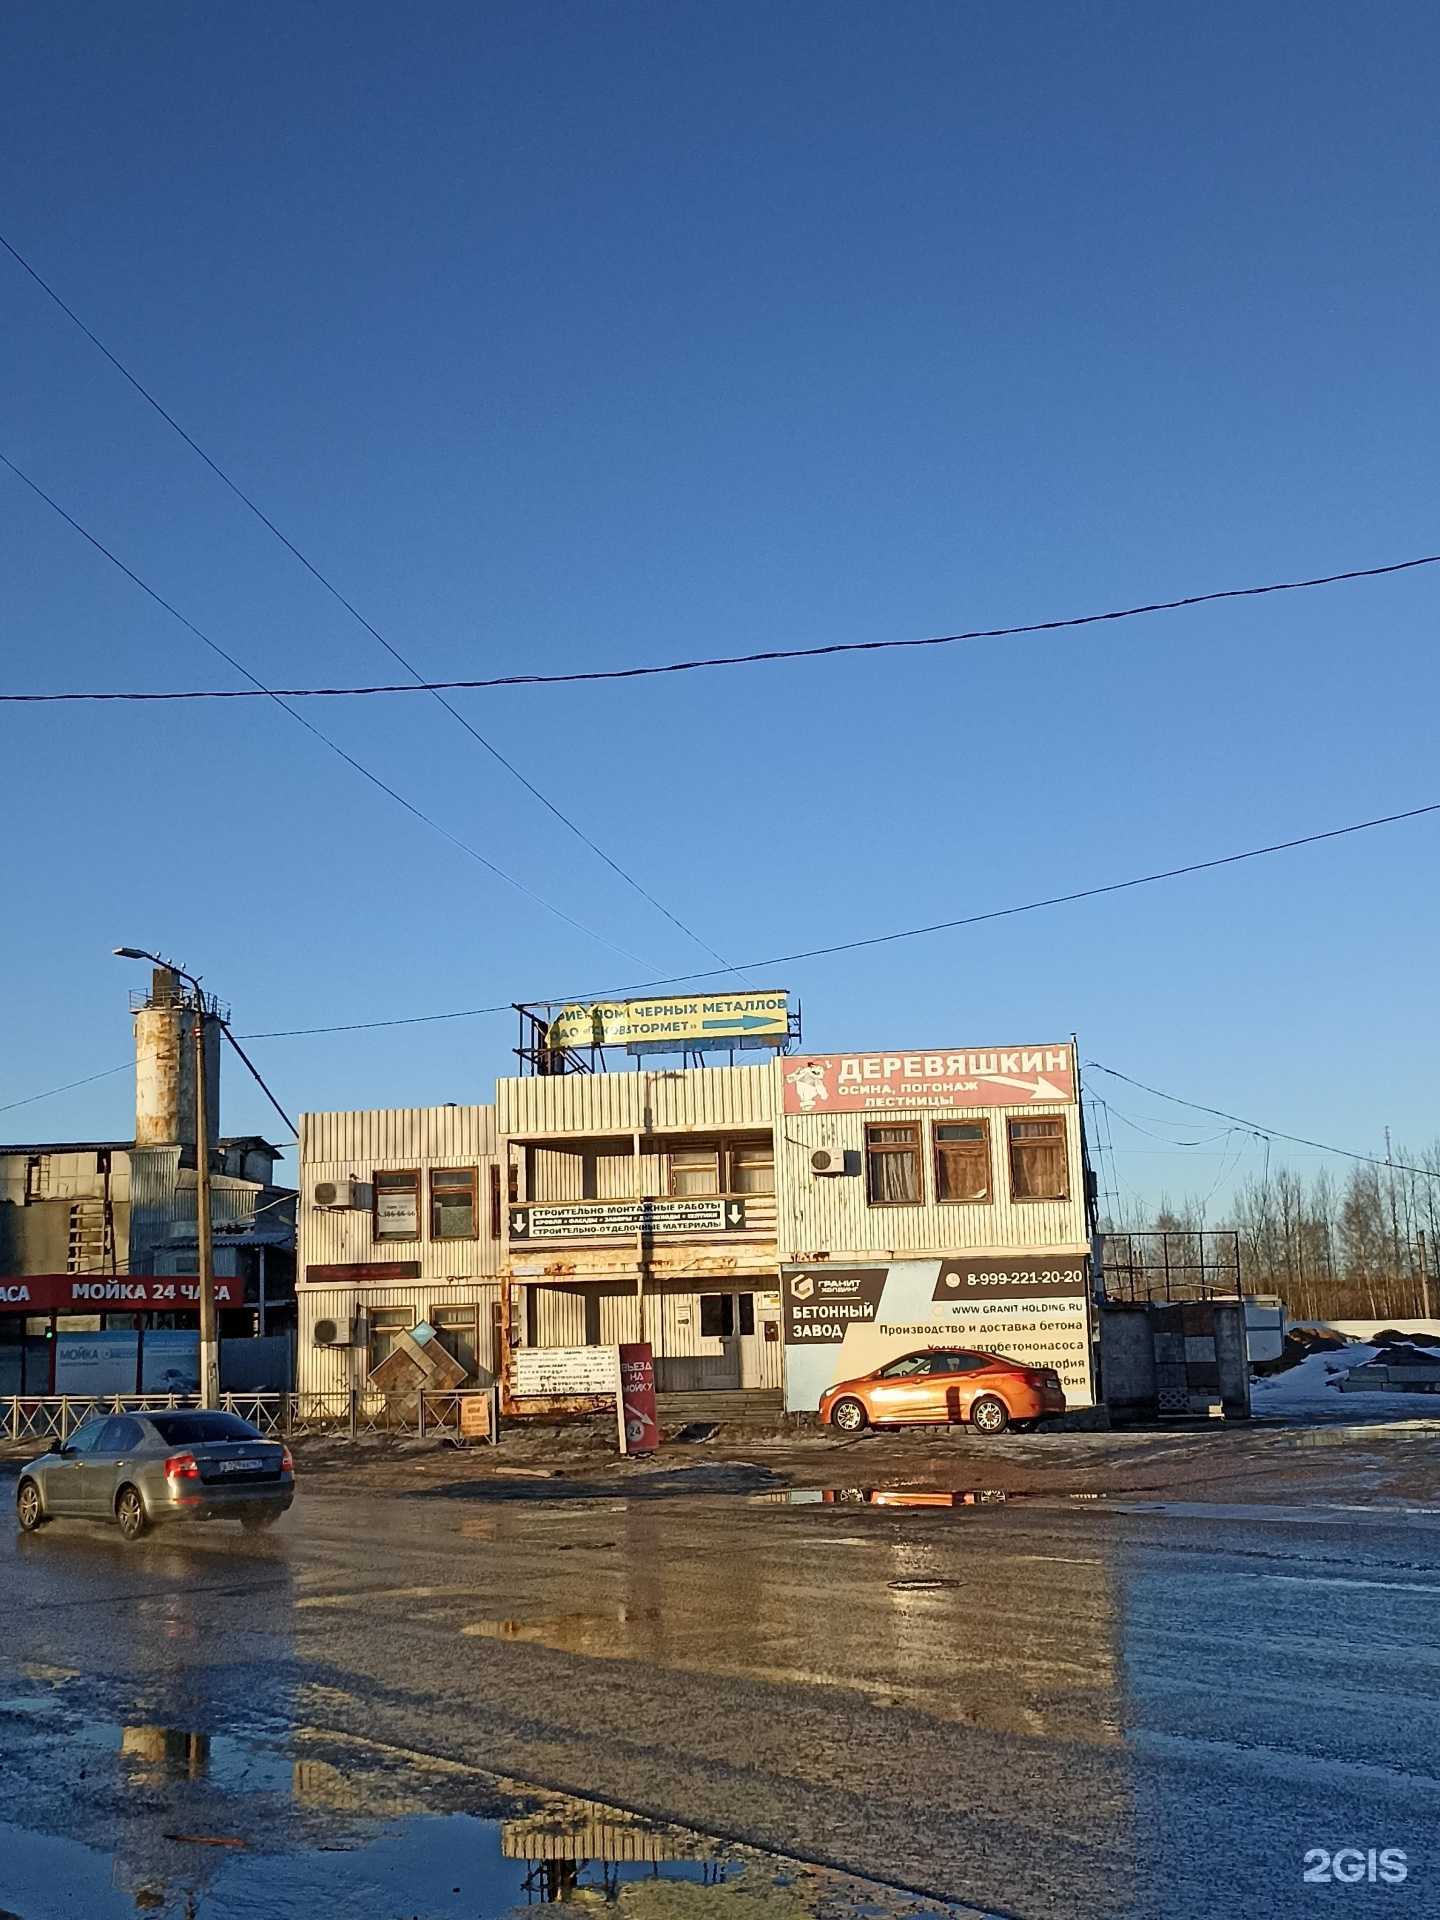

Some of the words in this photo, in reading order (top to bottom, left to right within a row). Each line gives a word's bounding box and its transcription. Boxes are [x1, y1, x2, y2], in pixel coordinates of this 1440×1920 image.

[635, 1003, 698, 1018] ЧЕРНЫХ
[702, 999, 787, 1013] МЕТАЛЛОВ
[838, 1050, 1067, 1084] ДЕРЕВЯШКИН
[838, 1083, 896, 1096] ОСИНА,
[901, 1081, 978, 1094] ПОГОНАЖ
[864, 1095, 954, 1108] ЛЕСТНИЦЫ
[677, 1202, 721, 1211] РАБОТЫ
[663, 1221, 722, 1230] МАТЕРИАЛЫ
[818, 1279, 861, 1287] ГРАНИТ
[966, 1270, 1083, 1286] 8-999-221-20-20
[0, 1285, 31, 1301] АСА
[71, 1279, 147, 1300] МОЙКА
[152, 1284, 176, 1299] 24
[180, 1284, 231, 1299] ЧА
[792, 1301, 874, 1319] БЕТОННЫЙ
[792, 1323, 844, 1338] ЗАВОД
[879, 1322, 965, 1336] Производство
[969, 1325, 976, 1333] и
[979, 1322, 1036, 1334] доставка
[1039, 1320, 1083, 1331] бетона
[630, 1371, 645, 1381] НА
[629, 1425, 642, 1437] 24
